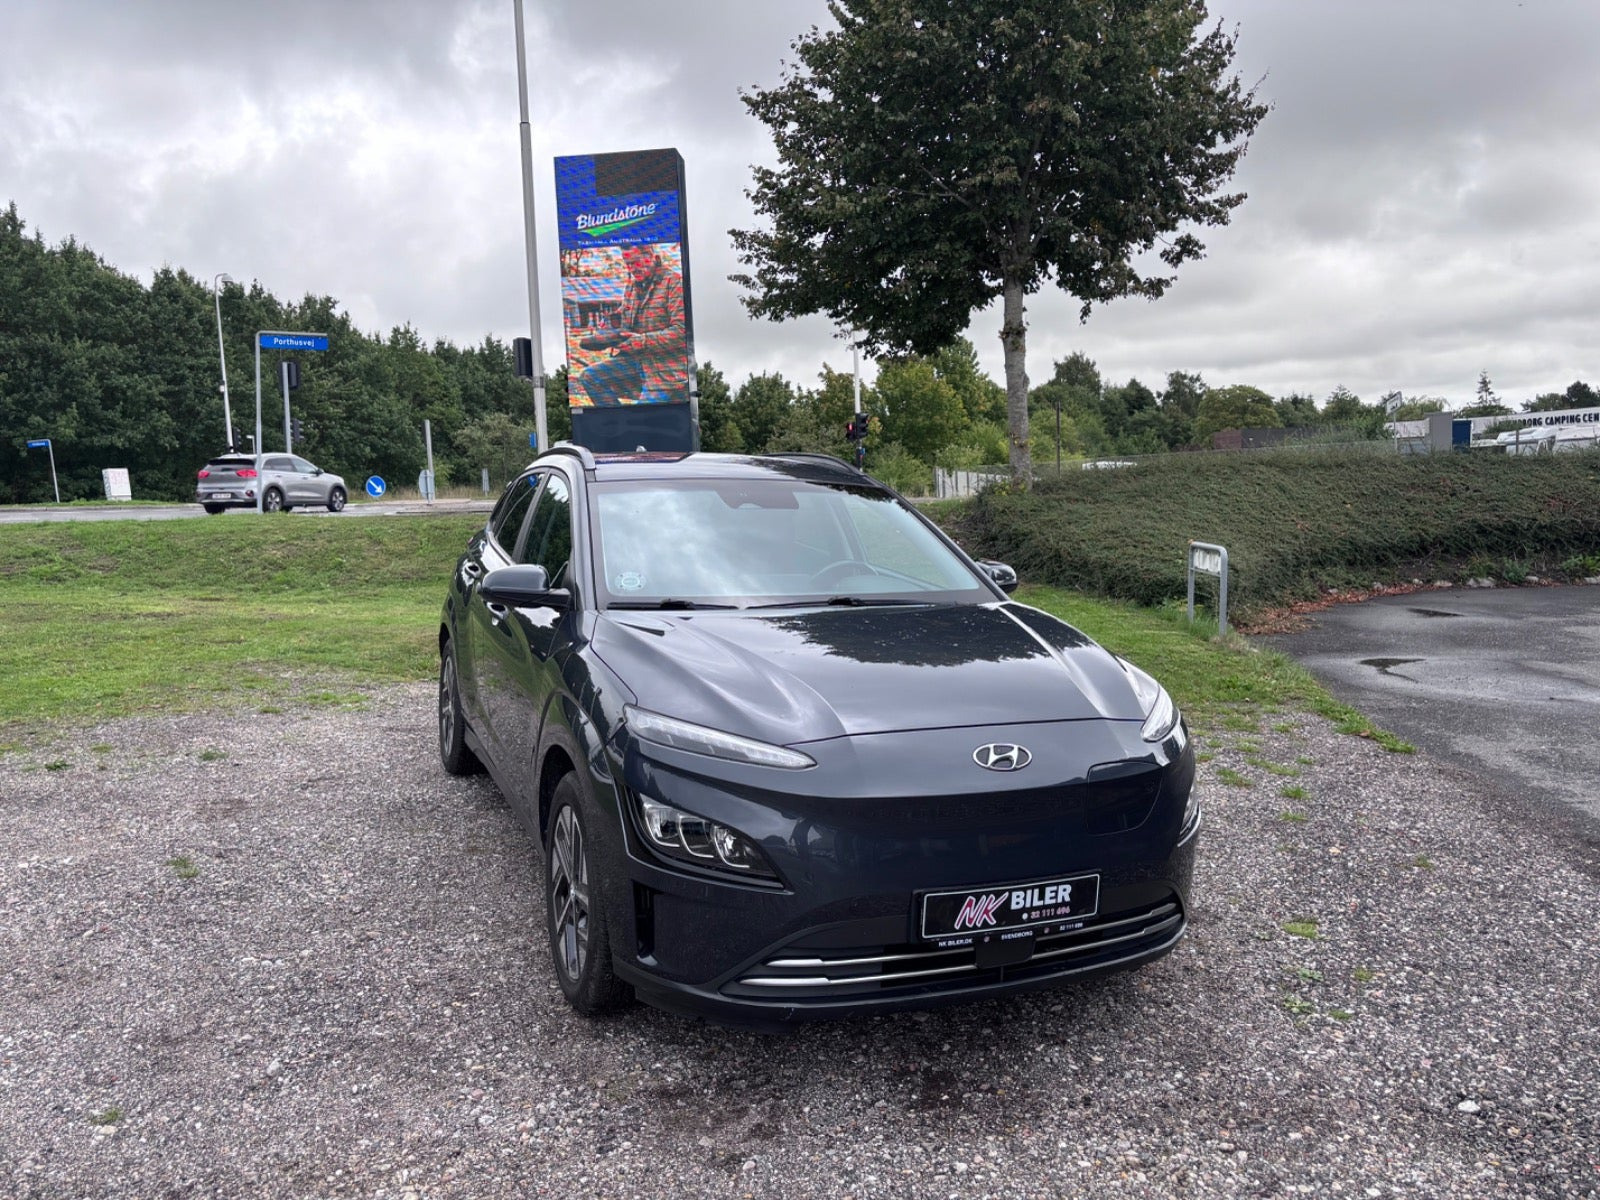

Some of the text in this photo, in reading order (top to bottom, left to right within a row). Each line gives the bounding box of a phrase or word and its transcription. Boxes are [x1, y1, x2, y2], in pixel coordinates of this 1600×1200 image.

[576, 203, 656, 230] Blundstone
[273, 337, 315, 347] Porthusvej
[1544, 414, 1581, 426] CAMPING
[954, 884, 1072, 930] NK BILER
